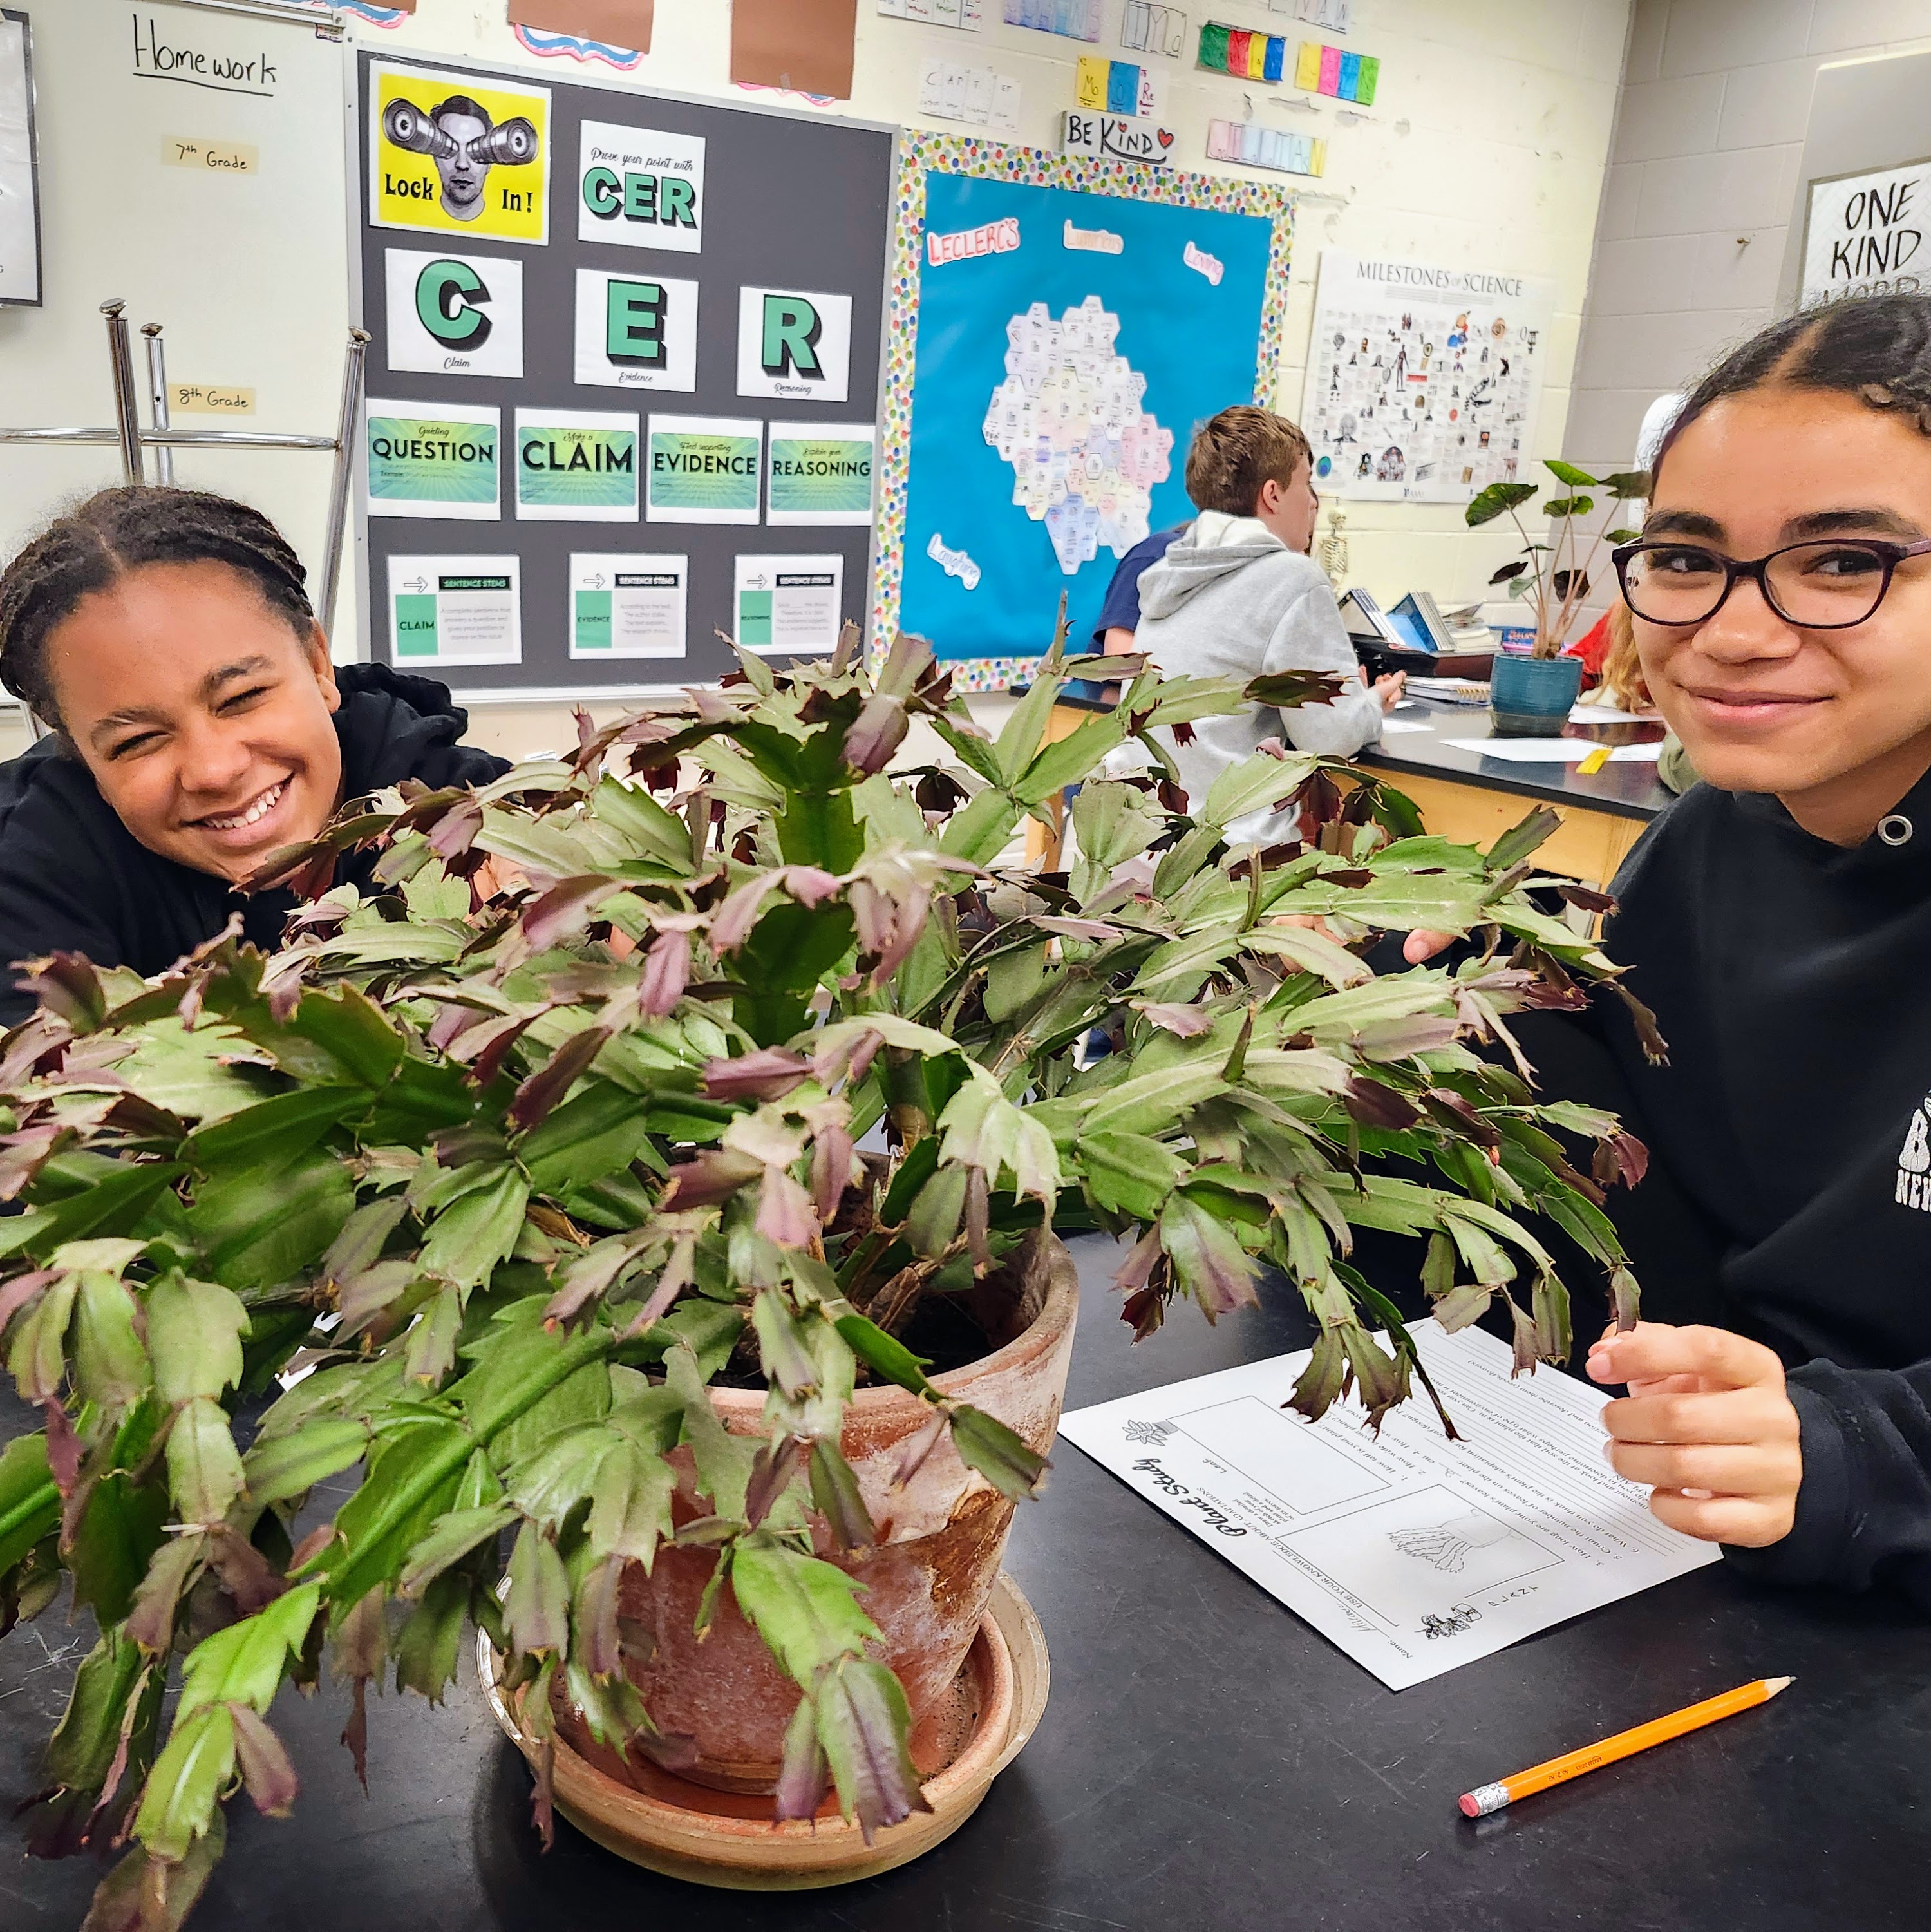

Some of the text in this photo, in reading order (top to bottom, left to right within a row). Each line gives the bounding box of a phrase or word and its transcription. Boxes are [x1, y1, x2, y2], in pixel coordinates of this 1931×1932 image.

[133, 14, 276, 84] Homework
[1067, 115, 1093, 146] BE
[175, 143, 248, 170] 7th Grade
[591, 147, 693, 171] Prove your point with
[385, 173, 435, 201] Lock
[583, 166, 698, 229] CER
[1845, 179, 1921, 231] ONE
[929, 219, 1019, 261] LECLERC'S
[1831, 229, 1922, 279] KIND
[1356, 260, 1451, 288] MILESTONES
[1462, 273, 1523, 297] SCIENCE
[416, 259, 492, 350] C
[607, 278, 668, 369] E
[762, 294, 825, 381] R
[444, 356, 471, 369] Claim
[619, 372, 654, 384] Evidence
[179, 387, 249, 409] 8th Grade
[419, 426, 449, 439] Guiding
[372, 437, 494, 464] QUESTION
[522, 440, 633, 473] CLAIM
[654, 453, 756, 475] EVIDENCE
[773, 460, 871, 477] REASONING
[443, 579, 482, 588] SENTENCE
[399, 620, 435, 630] CLAIM
[1326, 1417, 1357, 1430] plant?
[1402, 1414, 1431, 1429] design?
[1567, 1413, 1584, 1421] and
[1317, 1425, 1343, 1438] plant?
[1427, 1427, 1447, 1438] leaf
[1494, 1421, 1516, 1432] plant
[1515, 1427, 1538, 1439] what
[1354, 1428, 1376, 1441] your
[1340, 1438, 1360, 1448] your
[1391, 1438, 1411, 1448] How
[1526, 1439, 1543, 1448] that
[1539, 1438, 1570, 1457] perhaps
[1363, 1453, 1377, 1461] tall
[1379, 1446, 1396, 1457] wide
[1541, 1448, 1558, 1457] soil
[1202, 1459, 1227, 1473] Leaf
[1377, 1462, 1396, 1473] How
[1397, 1457, 1415, 1468] How
[1456, 1460, 1481, 1474] plant:
[1467, 1450, 1506, 1473] adaptation
[1568, 1457, 1607, 1479] determine
[1506, 1473, 1534, 1489] plant's
[1579, 1470, 1599, 1482] look
[1460, 1480, 1490, 1497] leaves?
[1597, 1481, 1615, 1490] and
[1131, 1458, 1247, 1537] Plant Study
[1503, 1488, 1529, 1504] leaves
[1614, 1490, 1650, 1510] moment
[1490, 1497, 1518, 1513] plant's
[1554, 1502, 1576, 1515] think
[1257, 1517, 1273, 1527] Draw
[1263, 1512, 1281, 1524] sketch
[1272, 1512, 1289, 1522] plant
[1515, 1513, 1538, 1524] your
[1538, 1510, 1572, 1528] number
[1576, 1515, 1594, 1525] you
[1550, 1532, 1570, 1545] long
[1570, 1528, 1585, 1537] the
[1196, 1487, 1362, 1608] USE YOUR KNOWLEDGE ABOUT ADAPTATIONS
[1584, 1537, 1611, 1553] Count
[1605, 1533, 1626, 1548] What
[1569, 1546, 1592, 1558] How
[1387, 1640, 1413, 1659] Name:
